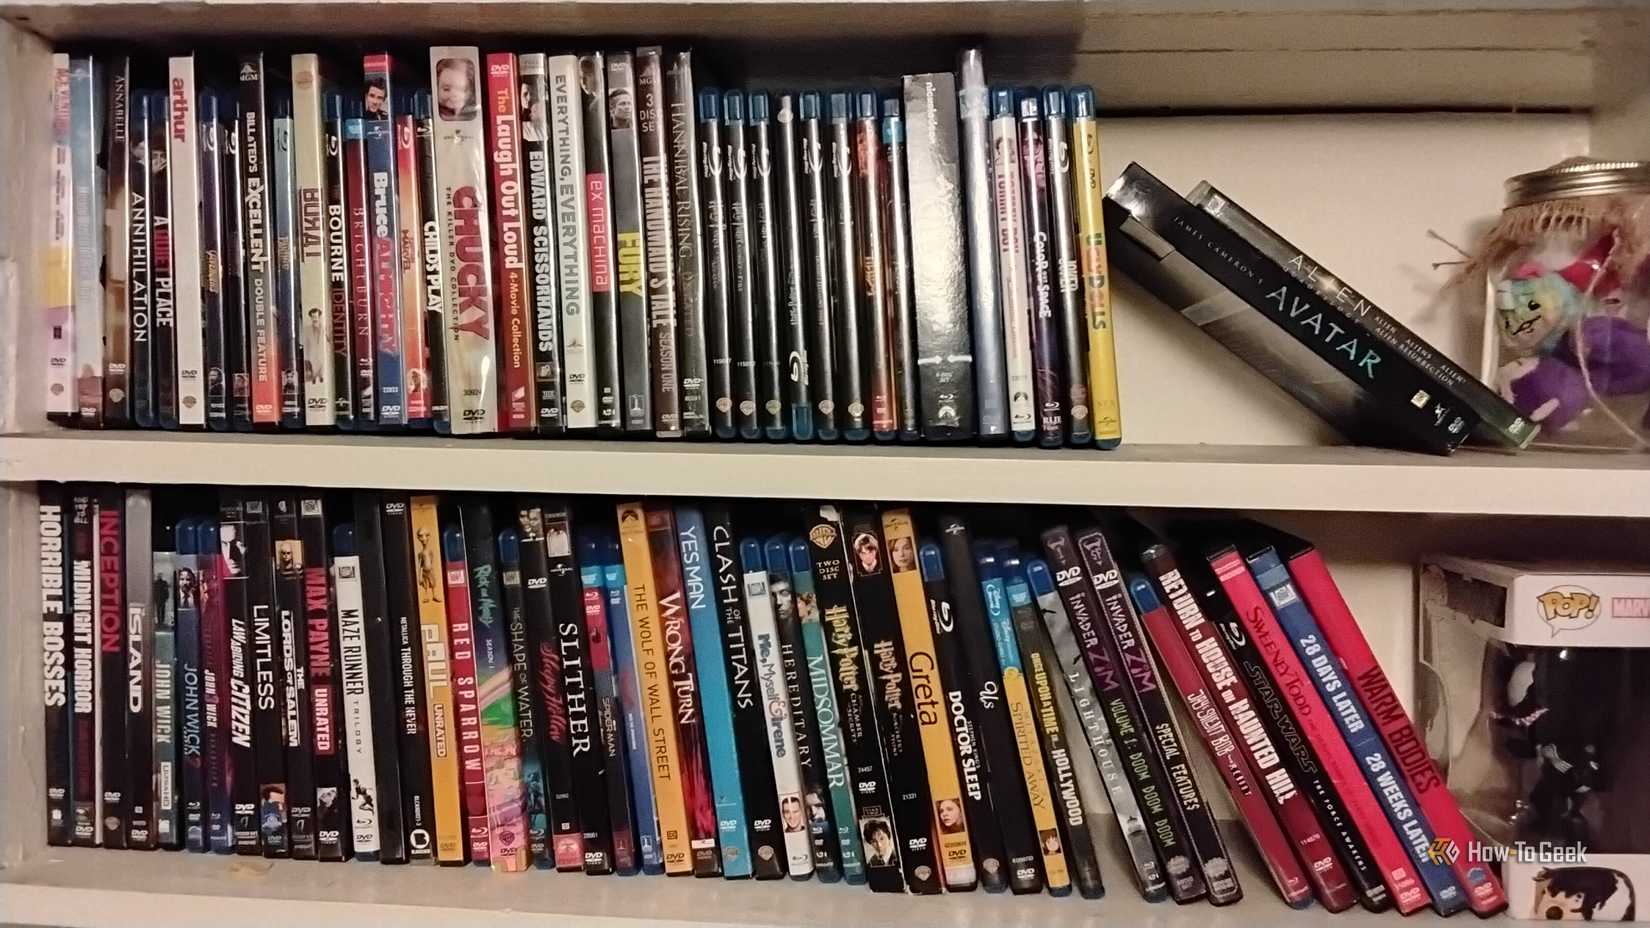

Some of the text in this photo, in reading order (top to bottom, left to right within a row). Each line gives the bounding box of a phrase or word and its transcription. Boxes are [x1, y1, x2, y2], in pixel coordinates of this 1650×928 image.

[115, 76, 126, 142] ANNABELLE
[172, 77, 190, 143] arthur
[245, 112, 255, 135] BILL
[646, 93, 654, 107] 3
[373, 172, 389, 238] Bruce
[494, 88, 524, 269] The Laugh Out Loud
[643, 156, 665, 184] THE
[671, 103, 693, 259] HANNIBAL RISING
[132, 192, 147, 342] ANNIHILATION
[246, 177, 269, 272] EXCELLENT
[451, 185, 489, 341] CHUCKY
[529, 150, 553, 352] EDWARD SCISSORHANDS
[559, 183, 580, 316] EVERYTHING
[618, 233, 644, 297] FURY
[155, 277, 173, 328] PLACE
[254, 279, 266, 326] DOUBLE
[329, 205, 347, 357] BOURNE IDENTITY
[353, 207, 369, 336] BRIGHTBURN
[427, 275, 442, 313] PLAY
[651, 292, 676, 328] TALE
[256, 330, 267, 382] FEATURE
[509, 272, 521, 369] 4-Movie Collection
[659, 332, 672, 367] SEASON
[1265, 285, 1383, 379] AVATAR
[1399, 344, 1456, 387] RESURRECTION
[463, 409, 485, 419] DVD
[661, 370, 673, 393] ONE
[39, 505, 66, 707] HORRIBLE BOSSES
[73, 560, 92, 644] MIDNIGHT
[101, 510, 121, 652] INCEPTION
[816, 559, 840, 568] TWO
[818, 566, 840, 574] DISC
[1056, 565, 1081, 584] DVD
[1536, 592, 1600, 620] POP!
[253, 604, 275, 711] LIMITLESS
[305, 568, 331, 751] MAX PAYNE UNRATED
[421, 624, 449, 699] PAUL
[485, 638, 496, 663] SEASON
[510, 622, 527, 671] SHAPE
[659, 591, 697, 726] WRONG TURN
[713, 525, 754, 709] CLASH TITANS
[824, 603, 860, 695] Harry Potter
[1246, 605, 1312, 717] SWEENEY TODD
[154, 660, 171, 743] JOHN WICK
[184, 664, 201, 756] JOHN WICK
[204, 670, 216, 697] JOHN
[206, 704, 218, 728] WICK
[230, 618, 251, 748] LAW ABIDING CITIZEN
[281, 610, 300, 747] LORDS SALEM
[297, 666, 305, 689] THE
[341, 608, 364, 754] MAZE RUNNER TRILOGY
[400, 616, 417, 735] METALLICA THROUGH THE NEVER
[452, 622, 482, 771] RED SPARROW
[559, 623, 591, 757] SLITHER
[634, 584, 672, 781] THE WOLF OF WALL STREET
[759, 662, 781, 704] Myself
[781, 644, 812, 768] HEREDITARY
[873, 640, 903, 710] Harry Potter
[908, 651, 939, 726] Greta
[979, 681, 999, 709] Us
[1069, 592, 1176, 848] INVADER ZIM VOLUME DOOM DOOM DOOM
[1106, 592, 1200, 811] INVADER ZIM SPECIAL FEATURES
[1159, 568, 1298, 805] RETURN TO HOUSE ON HAUNTED HILL
[1300, 634, 1320, 656] 28
[1311, 653, 1342, 693] DAYS
[1332, 690, 1366, 734] LATER
[433, 704, 446, 757] UNRATED
[807, 655, 845, 789] MIDSOMMAR
[948, 690, 982, 801] DOCTOR SLEEP
[1010, 701, 1048, 811] SPIRITED AWAY
[1030, 652, 1083, 826] ONCE UPON TIME HOLLYWOOD
[1068, 672, 1122, 795] LIGHTHOUSE
[1197, 707, 1226, 737] SILENT
[1211, 734, 1235, 757] BOB
[1243, 660, 1368, 871] STAR WARS THE FORCE AWAKENS
[1358, 664, 1441, 794] WARM BODIES
[1364, 752, 1387, 773] 28
[1376, 771, 1413, 821] WEEKS
